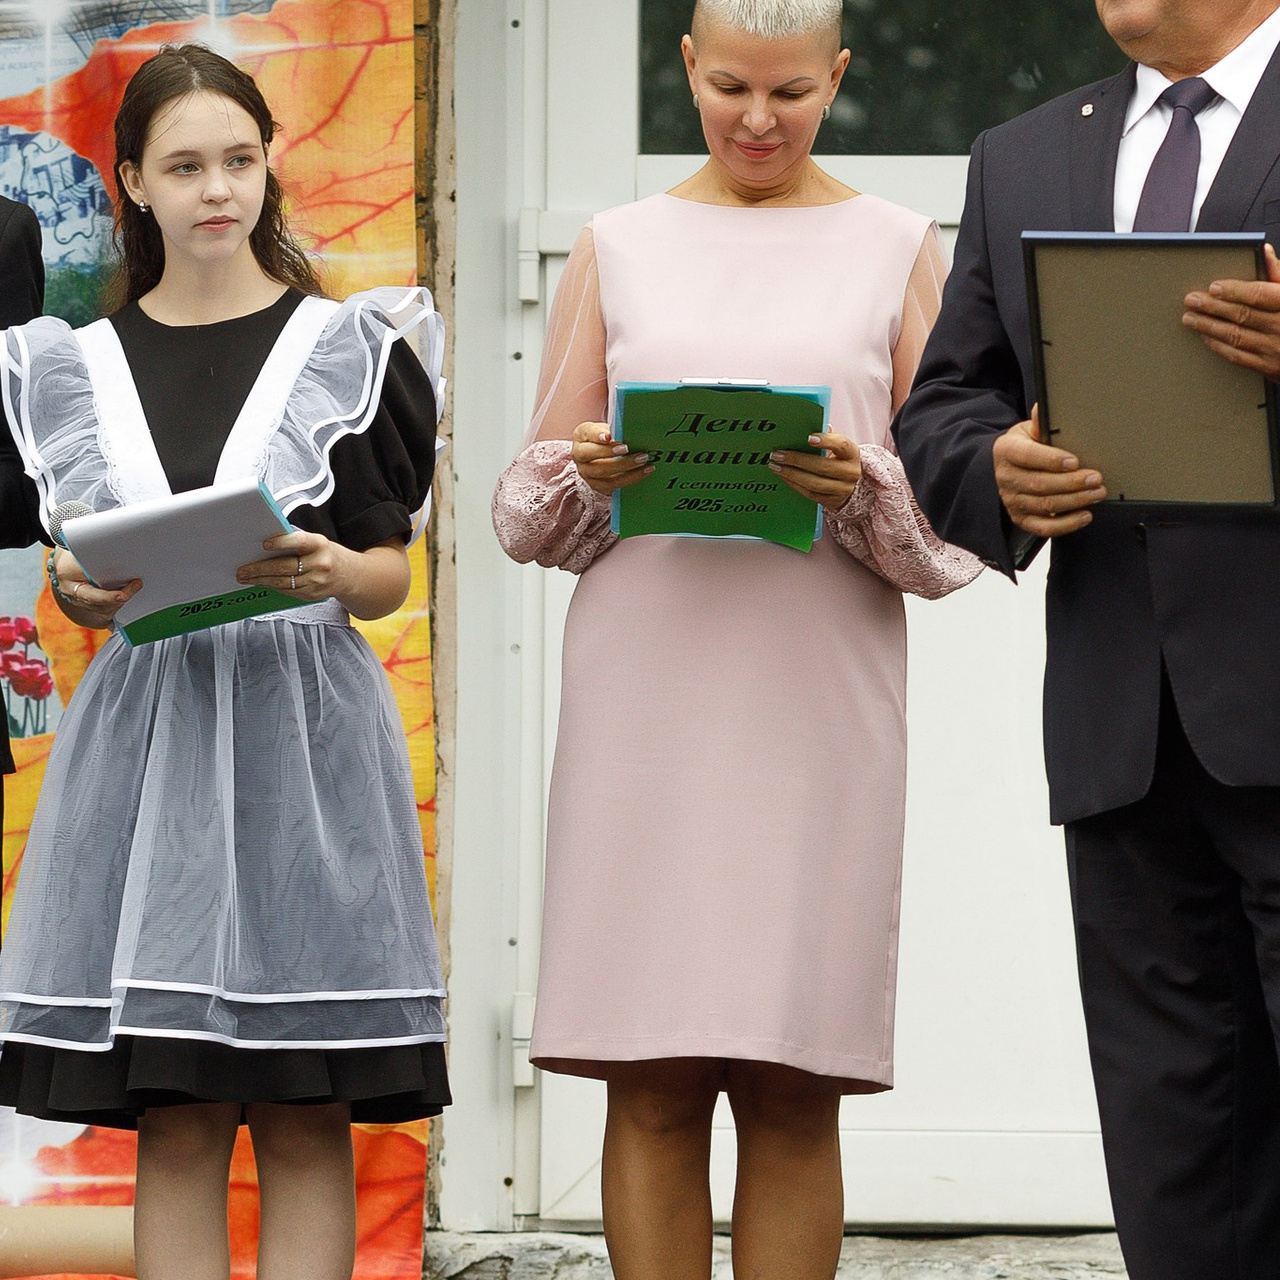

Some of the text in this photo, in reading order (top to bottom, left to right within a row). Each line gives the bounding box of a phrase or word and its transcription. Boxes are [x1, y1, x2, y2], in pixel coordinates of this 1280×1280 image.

[664, 412, 777, 437] День
[646, 448, 772, 466] знани
[665, 476, 778, 493] 1 сентября
[674, 498, 768, 512] 2025 года
[180, 591, 269, 617] 2025 года
